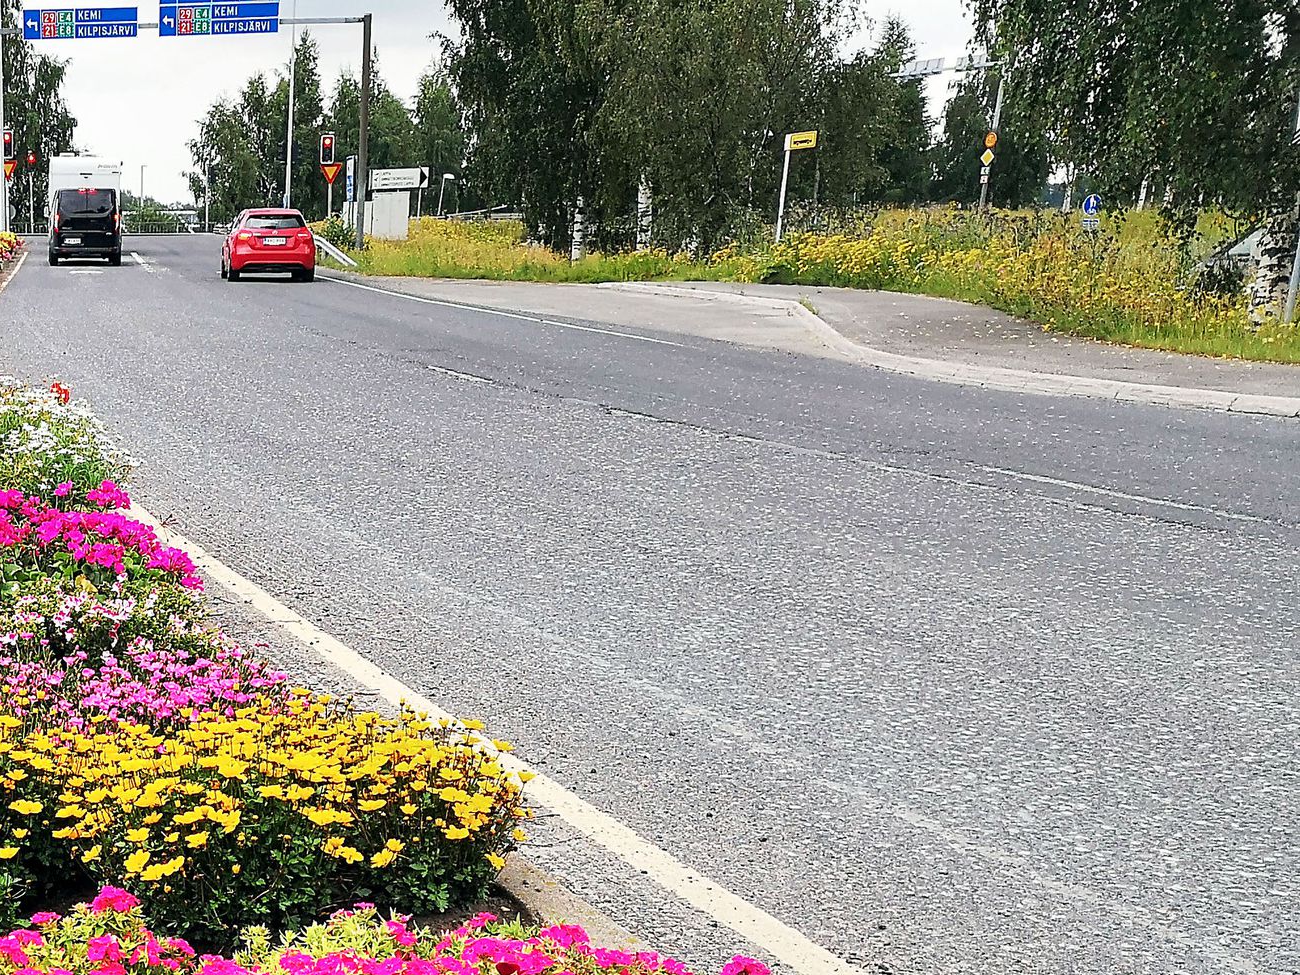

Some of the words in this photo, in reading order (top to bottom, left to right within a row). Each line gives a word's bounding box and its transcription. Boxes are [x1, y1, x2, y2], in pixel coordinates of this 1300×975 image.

[43, 13, 54, 23] 29
[78, 10, 101, 20] KEMI
[180, 9, 191, 19] 29
[214, 6, 238, 16] KEMI
[45, 26, 54, 36] 21
[78, 25, 133, 37] KILPISJÄRVI
[181, 22, 190, 32] 21
[214, 20, 270, 33] KILPISJÄRVI
